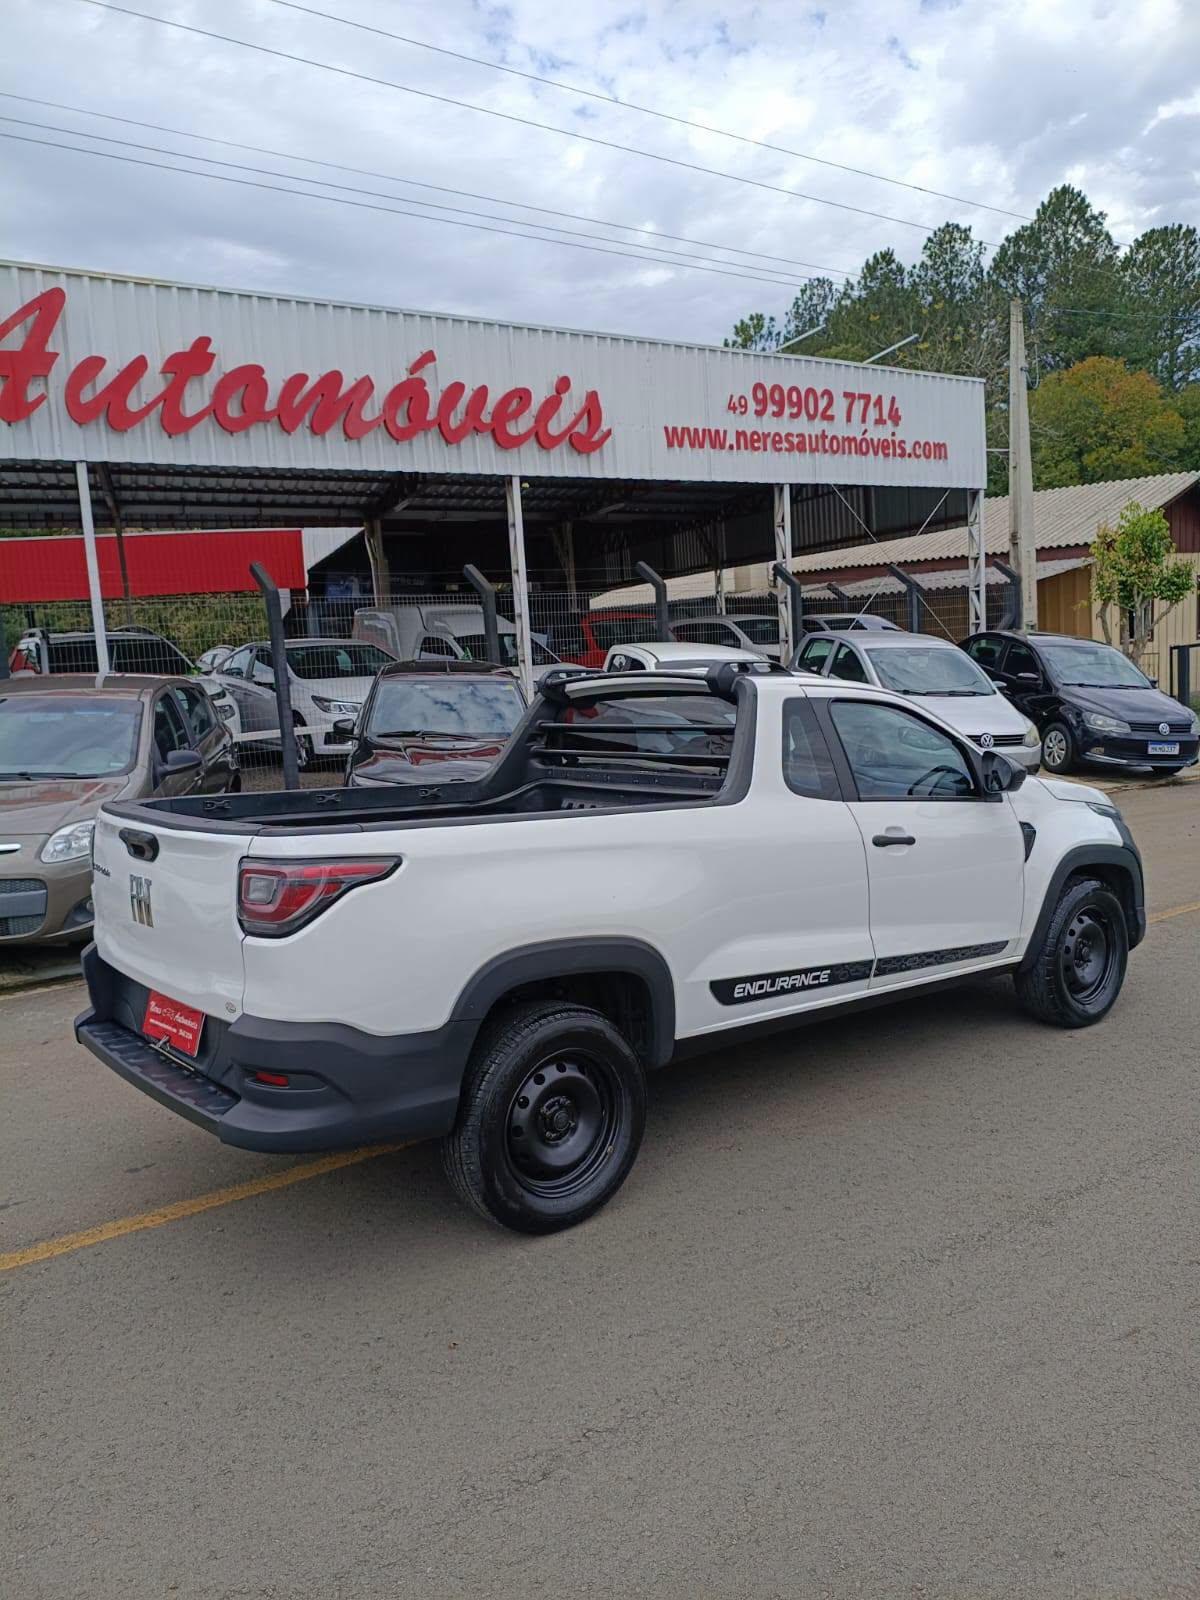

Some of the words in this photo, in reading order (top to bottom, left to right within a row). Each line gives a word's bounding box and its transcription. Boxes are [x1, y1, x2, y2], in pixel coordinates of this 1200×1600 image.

[0, 287, 612, 454] Automóveis
[727, 394, 748, 415] 49
[752, 382, 835, 421] 99902
[843, 392, 901, 427] 7714
[664, 426, 948, 460] www.neresautomóveis.com
[734, 971, 831, 998] ENDURANCE
